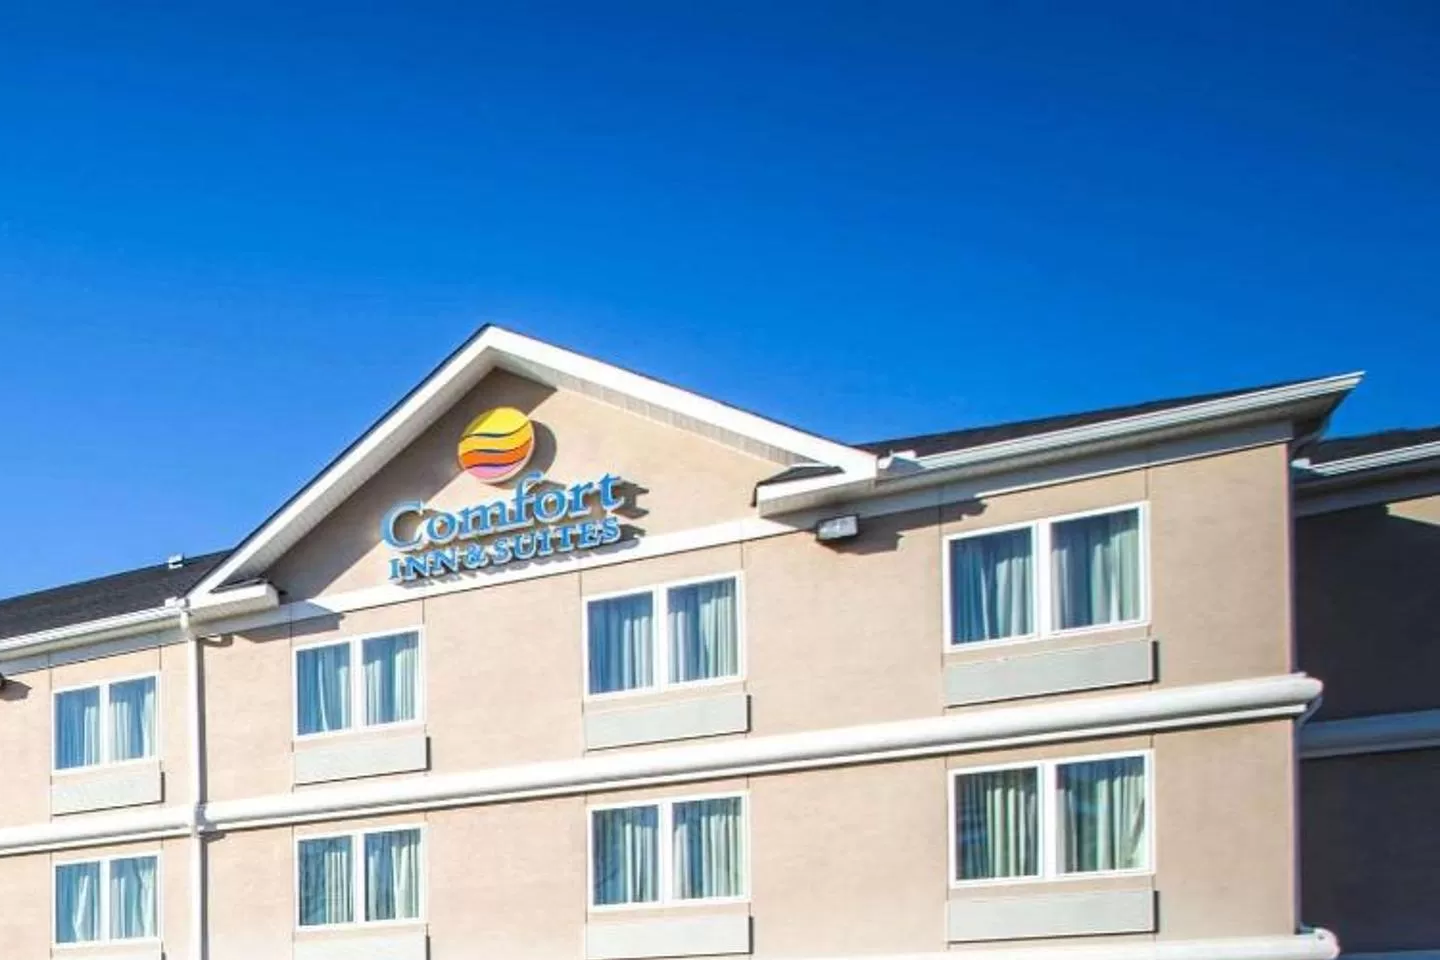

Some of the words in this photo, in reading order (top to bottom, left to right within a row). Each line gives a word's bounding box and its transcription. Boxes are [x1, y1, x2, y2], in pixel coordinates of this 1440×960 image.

[380, 471, 625, 551] Comfort
[388, 548, 460, 582] INN
[492, 516, 622, 564] SUITES
